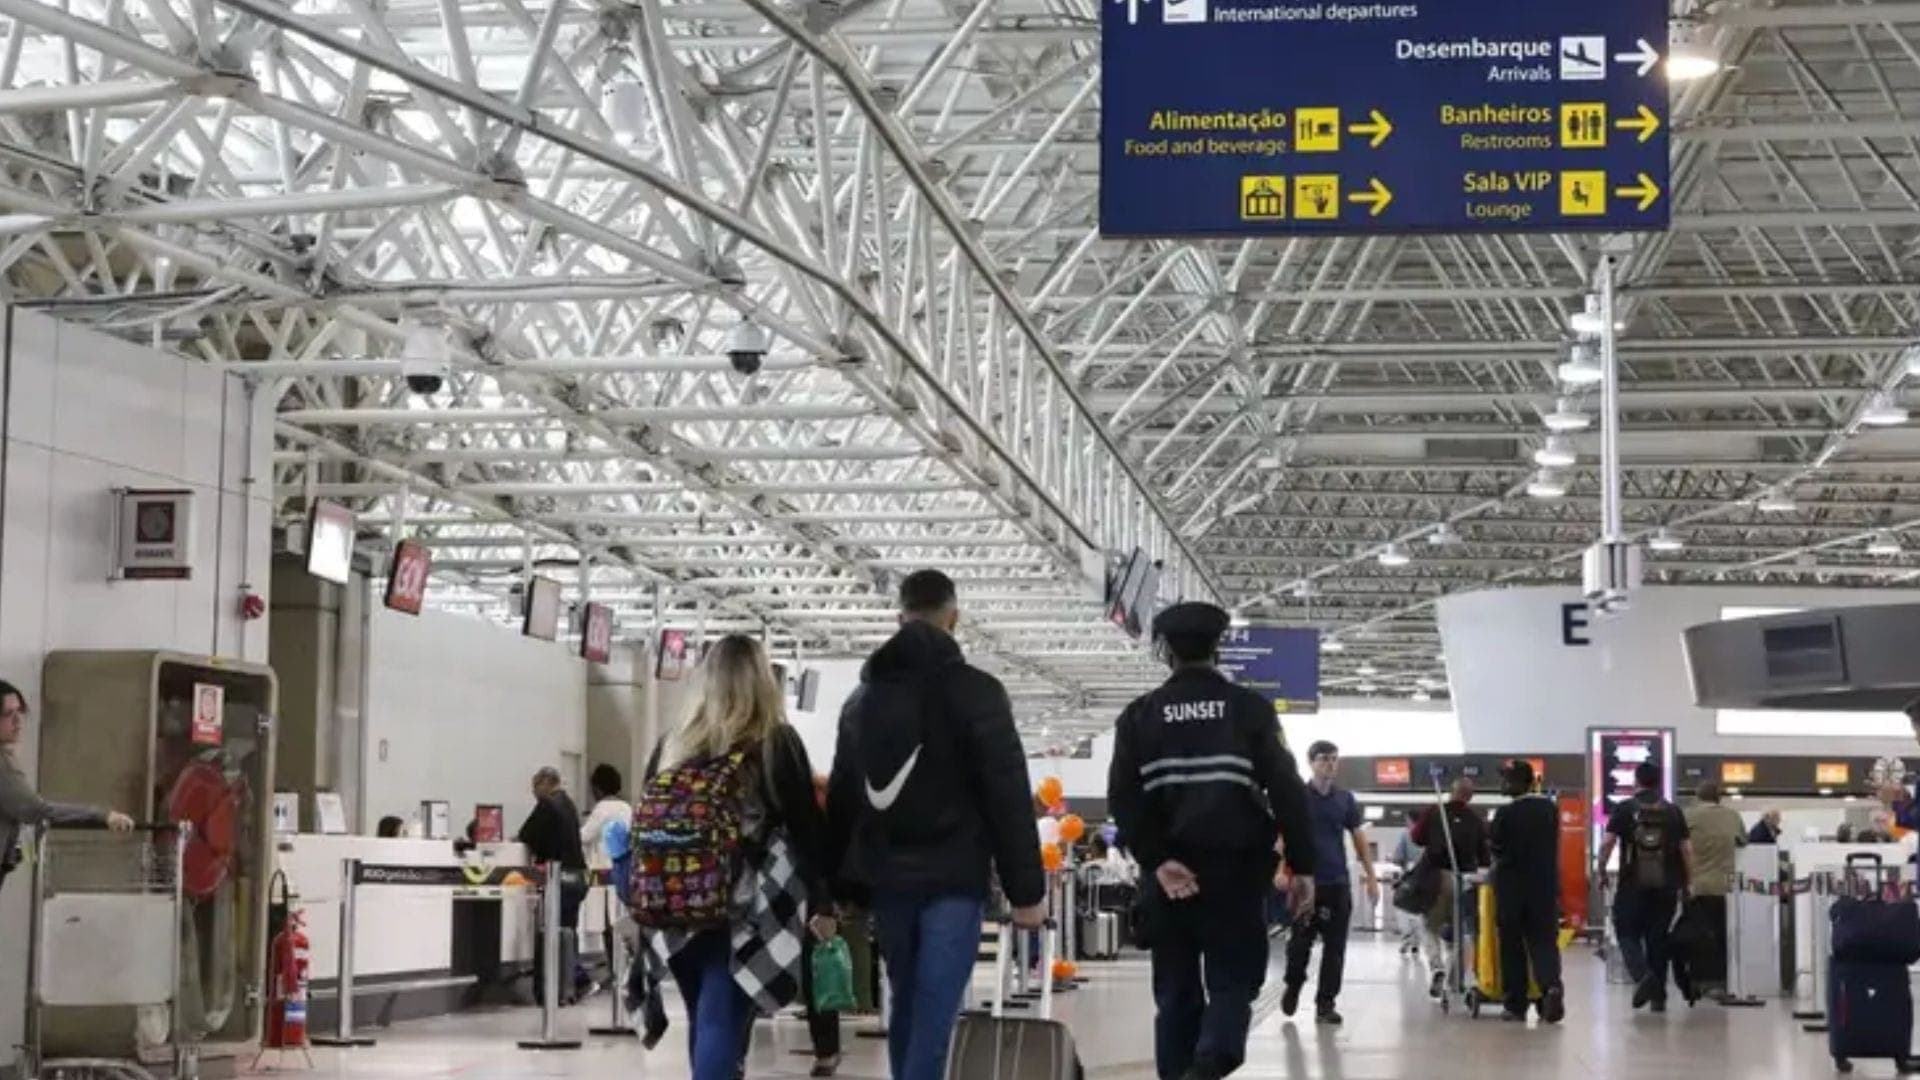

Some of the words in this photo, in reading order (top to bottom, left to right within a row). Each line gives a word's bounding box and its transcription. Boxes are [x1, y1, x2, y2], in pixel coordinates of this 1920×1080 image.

[1214, 4, 1322, 22] International
[1325, 3, 1418, 22] departures
[1396, 37, 1552, 61] Desembarque
[1487, 65, 1552, 82] Arrivals
[1149, 107, 1287, 133] Alimentação
[1441, 102, 1552, 125] Banheiros
[1124, 139, 1168, 155] Food
[1171, 139, 1204, 155] and
[1206, 138, 1287, 156] beverage
[1460, 133, 1552, 149] Restrooms
[1463, 170, 1511, 193] Sala
[1513, 170, 1552, 192] VIP
[1465, 201, 1532, 221] Lounge
[1561, 603, 1590, 646] E
[1163, 700, 1226, 723] SUNSET
